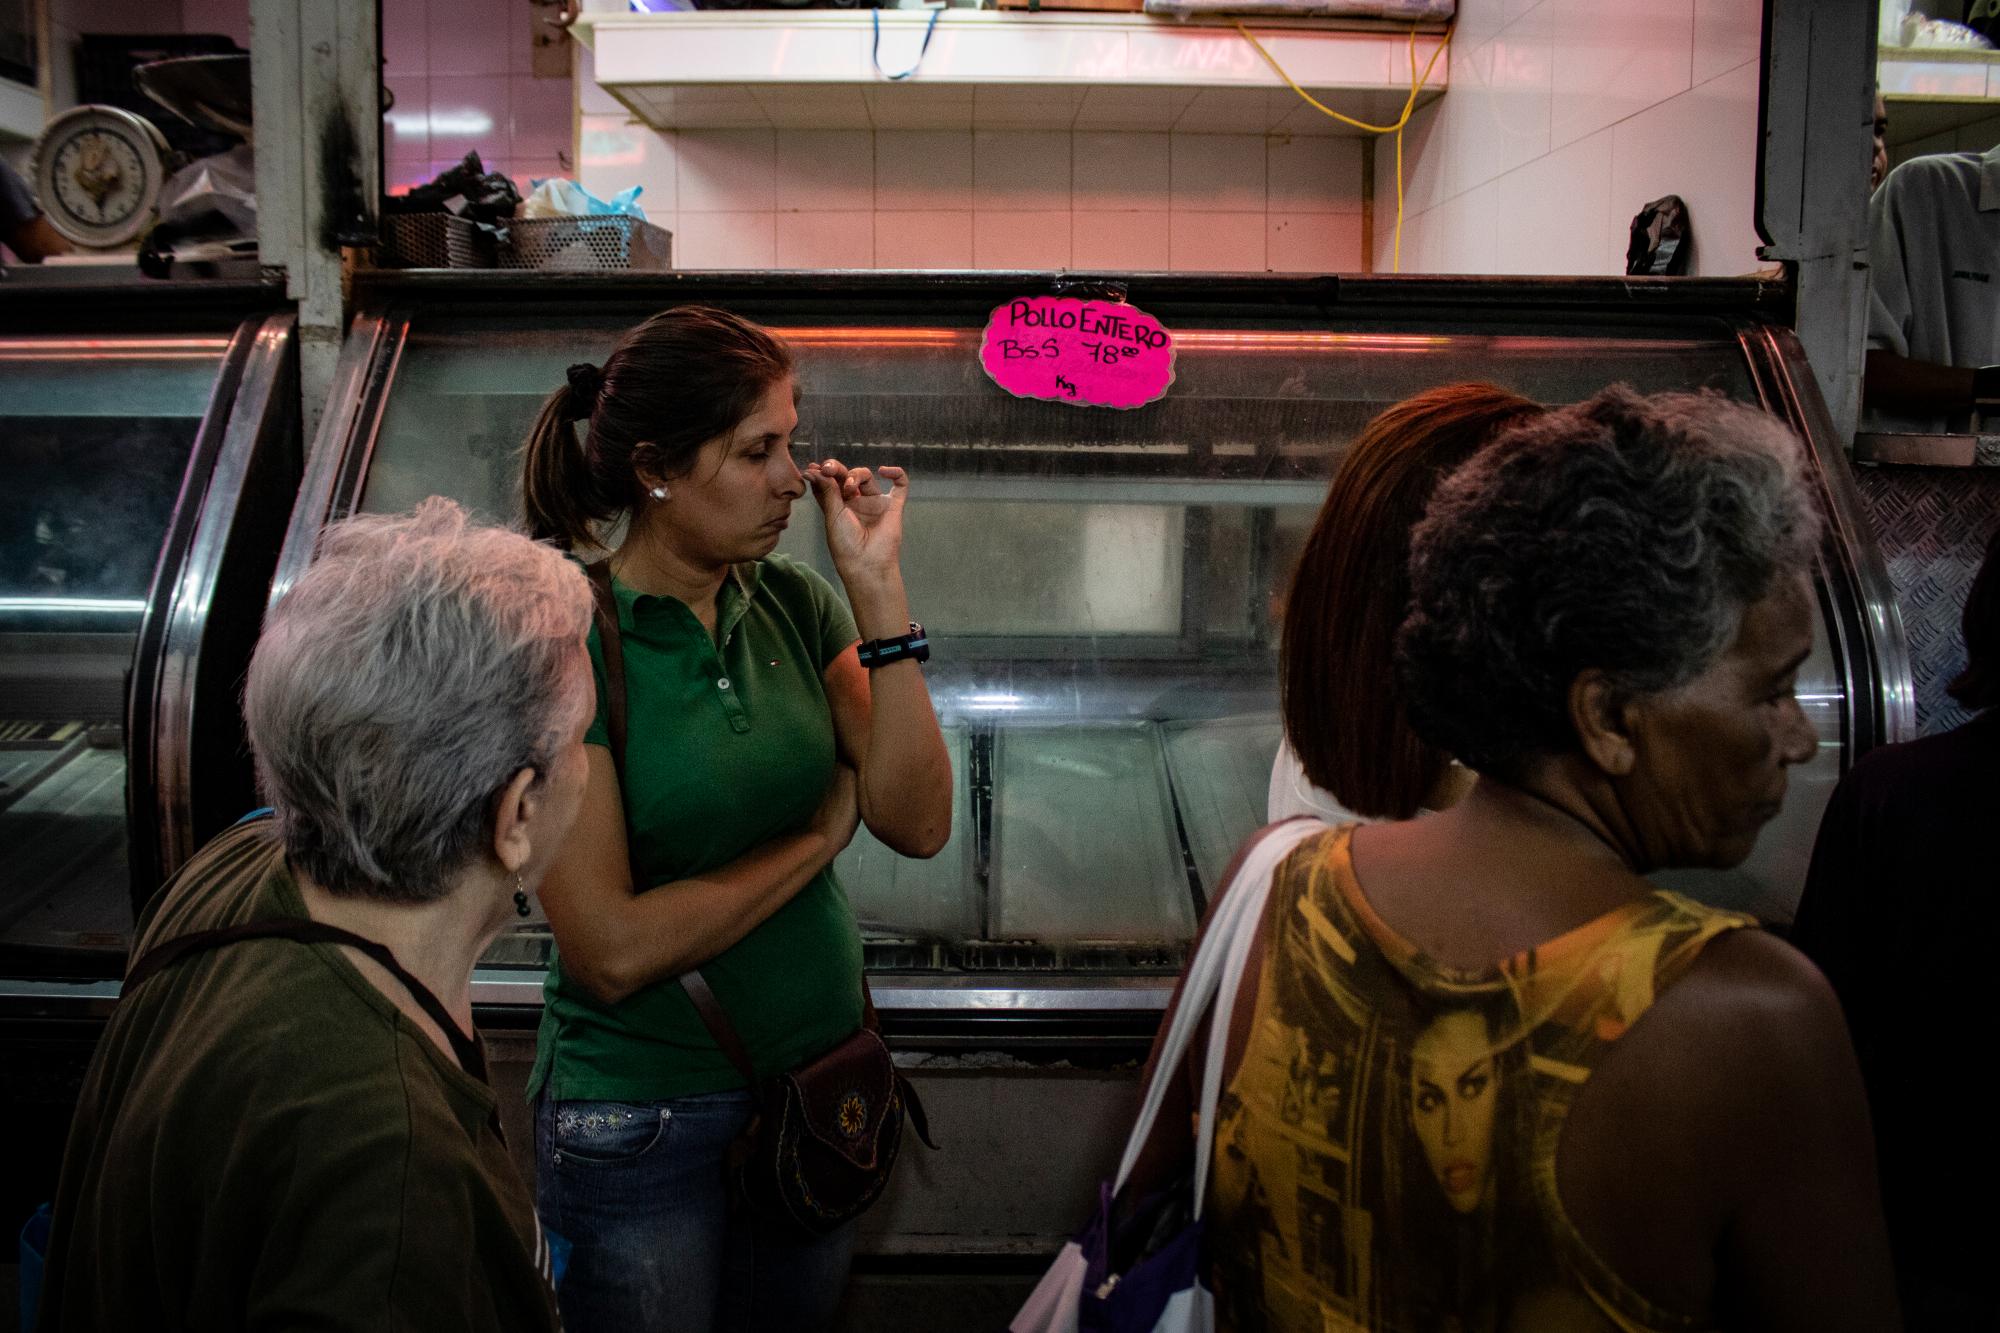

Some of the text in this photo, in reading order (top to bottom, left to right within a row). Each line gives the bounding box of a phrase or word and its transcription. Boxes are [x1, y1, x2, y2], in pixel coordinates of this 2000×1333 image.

[1010, 300, 1167, 349] POLLO ENTERO
[1055, 374, 1077, 397] Kg
